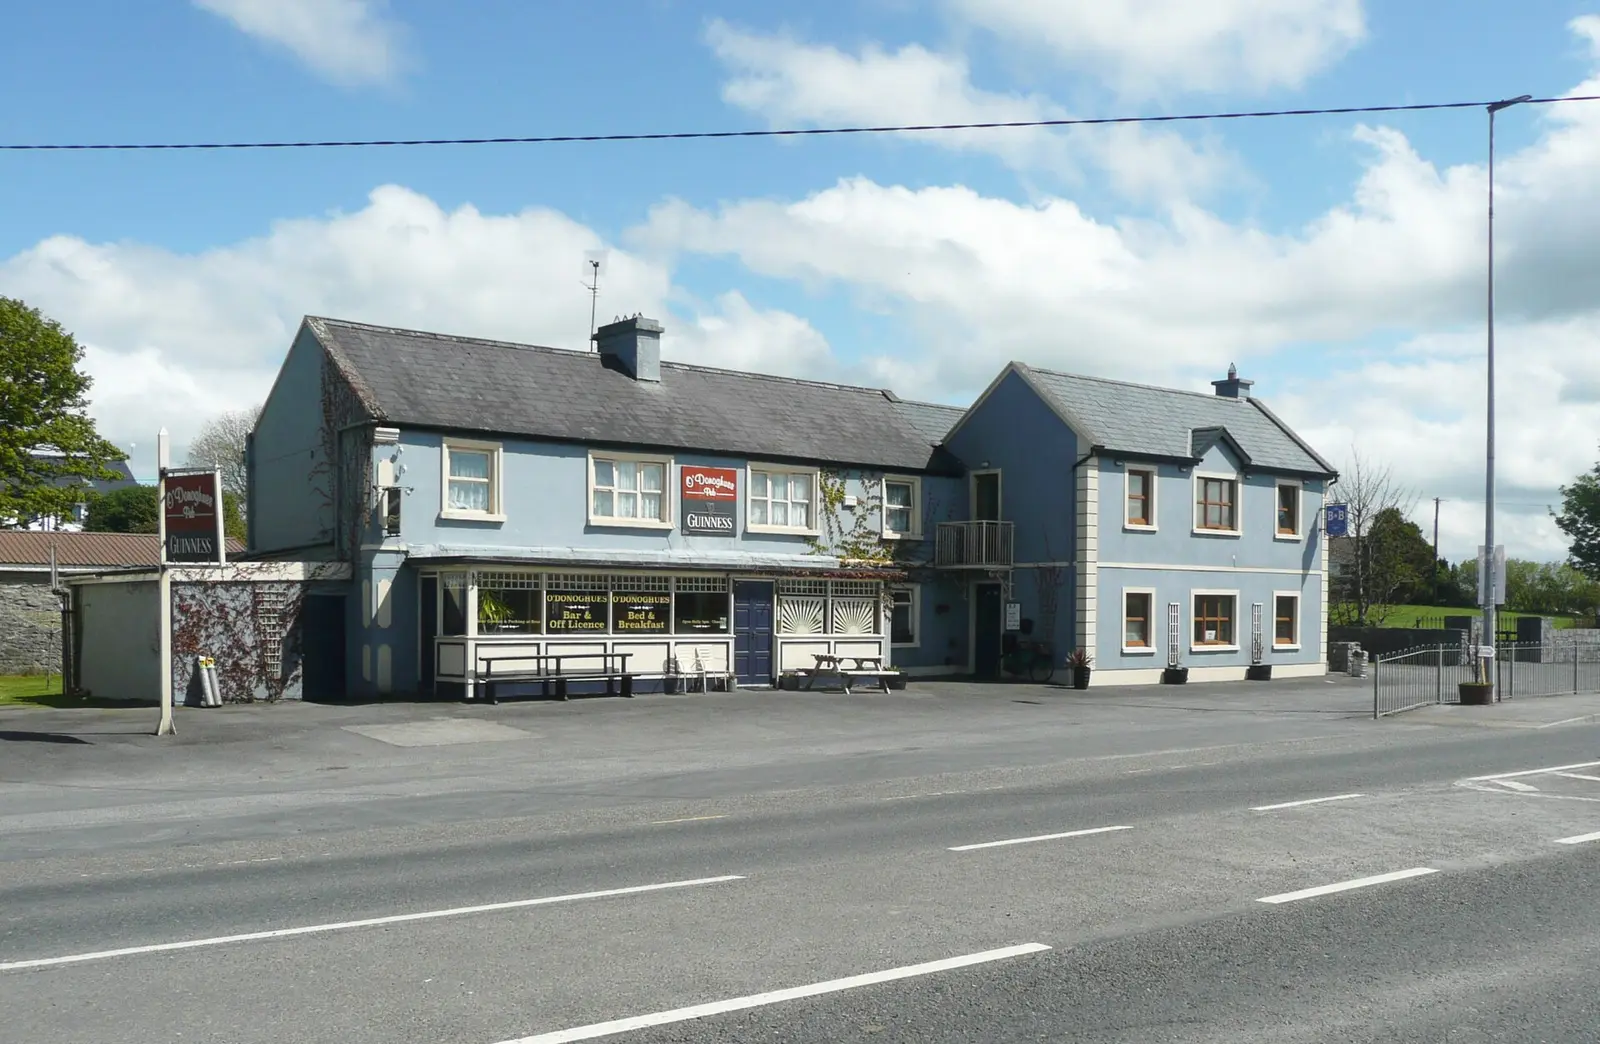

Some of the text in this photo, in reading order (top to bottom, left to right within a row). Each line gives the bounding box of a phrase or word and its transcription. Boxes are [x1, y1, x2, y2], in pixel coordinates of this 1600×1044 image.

[687, 513, 733, 529] GUINNESS
[170, 535, 212, 554] GUINNESS
[546, 594, 608, 603] O'DONOGHUES
[612, 596, 670, 604] O'DONOGHUES
[563, 610, 592, 620] Bar &
[627, 611, 656, 620] Bed &
[550, 619, 605, 629] Off Licence
[618, 620, 665, 629] Breakfast
